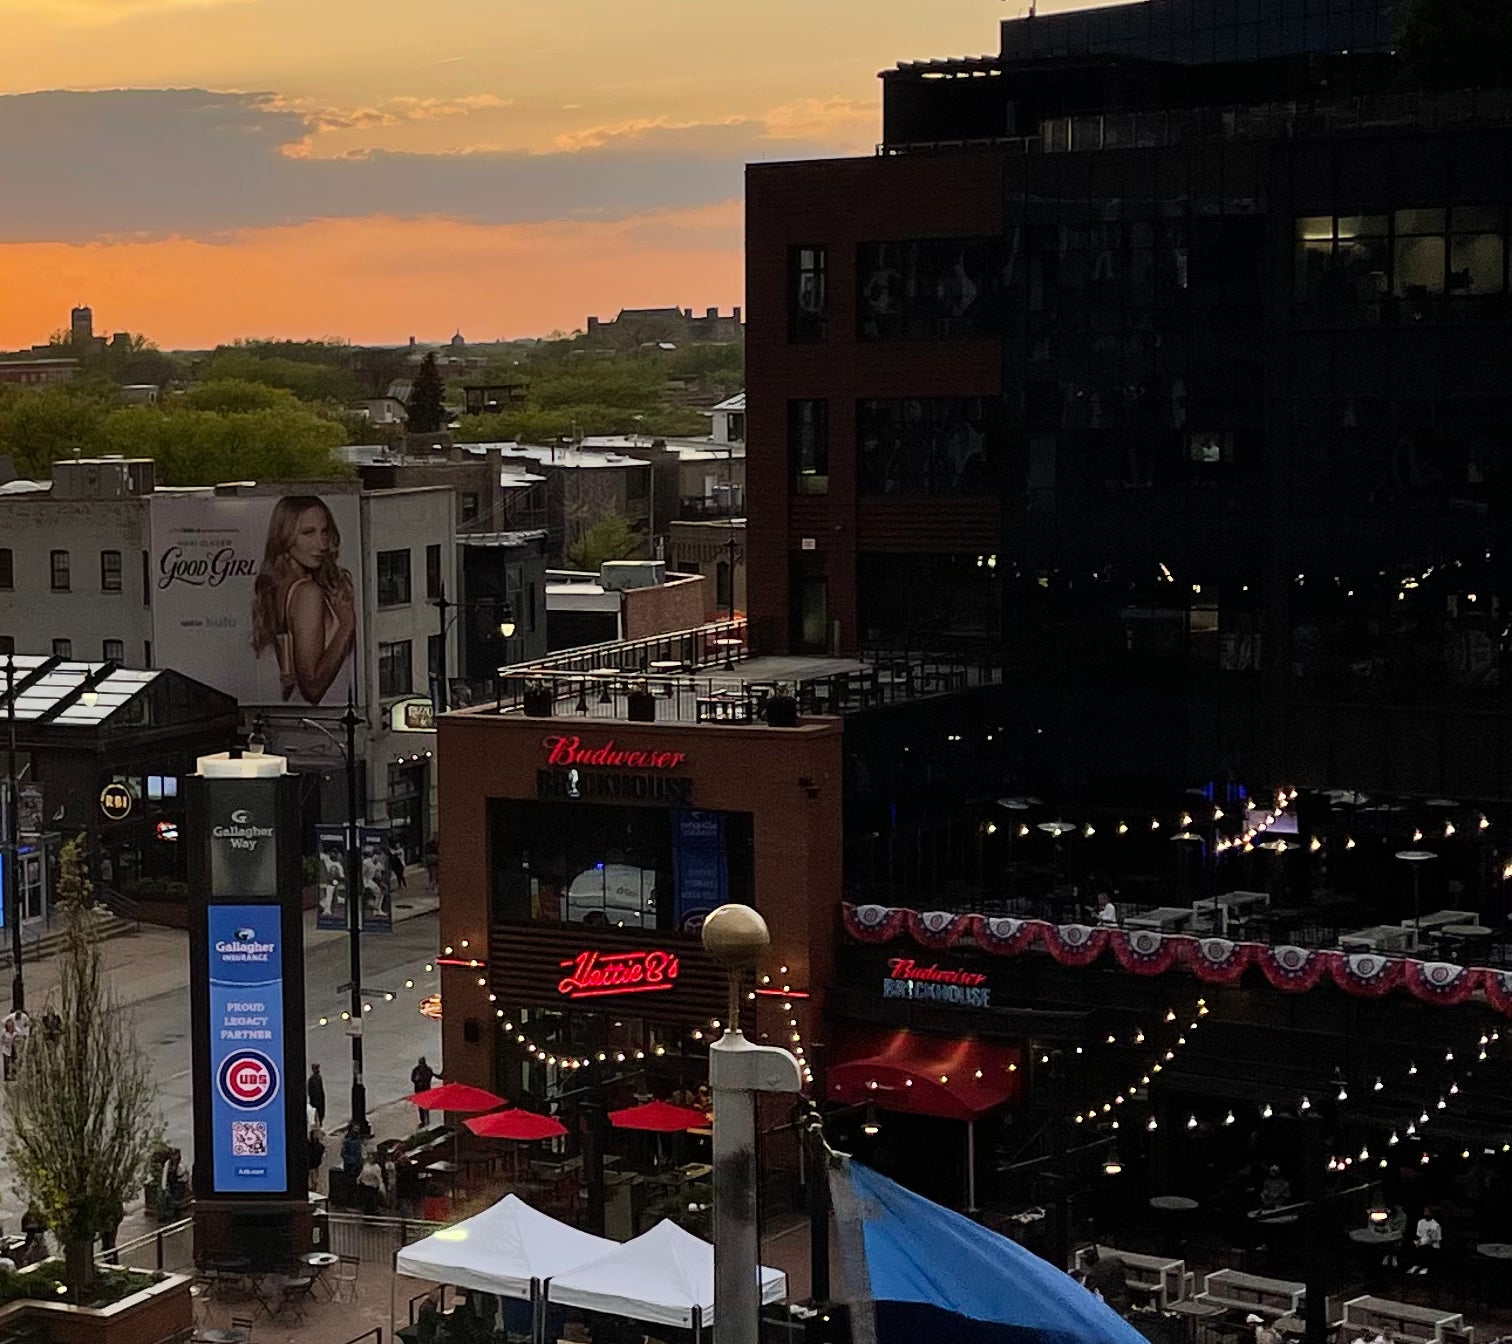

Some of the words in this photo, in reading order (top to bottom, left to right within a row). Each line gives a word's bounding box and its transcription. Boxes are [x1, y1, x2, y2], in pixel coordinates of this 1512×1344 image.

[542, 735, 686, 769] Budweiser
[105, 794, 128, 809] RBI
[213, 826, 274, 838] Gallagher
[230, 838, 257, 851] Way
[215, 940, 275, 955] Gallagher
[226, 1002, 265, 1013] PROUD
[223, 1016, 268, 1027] LEGACY
[220, 1029, 272, 1041] PARTNER
